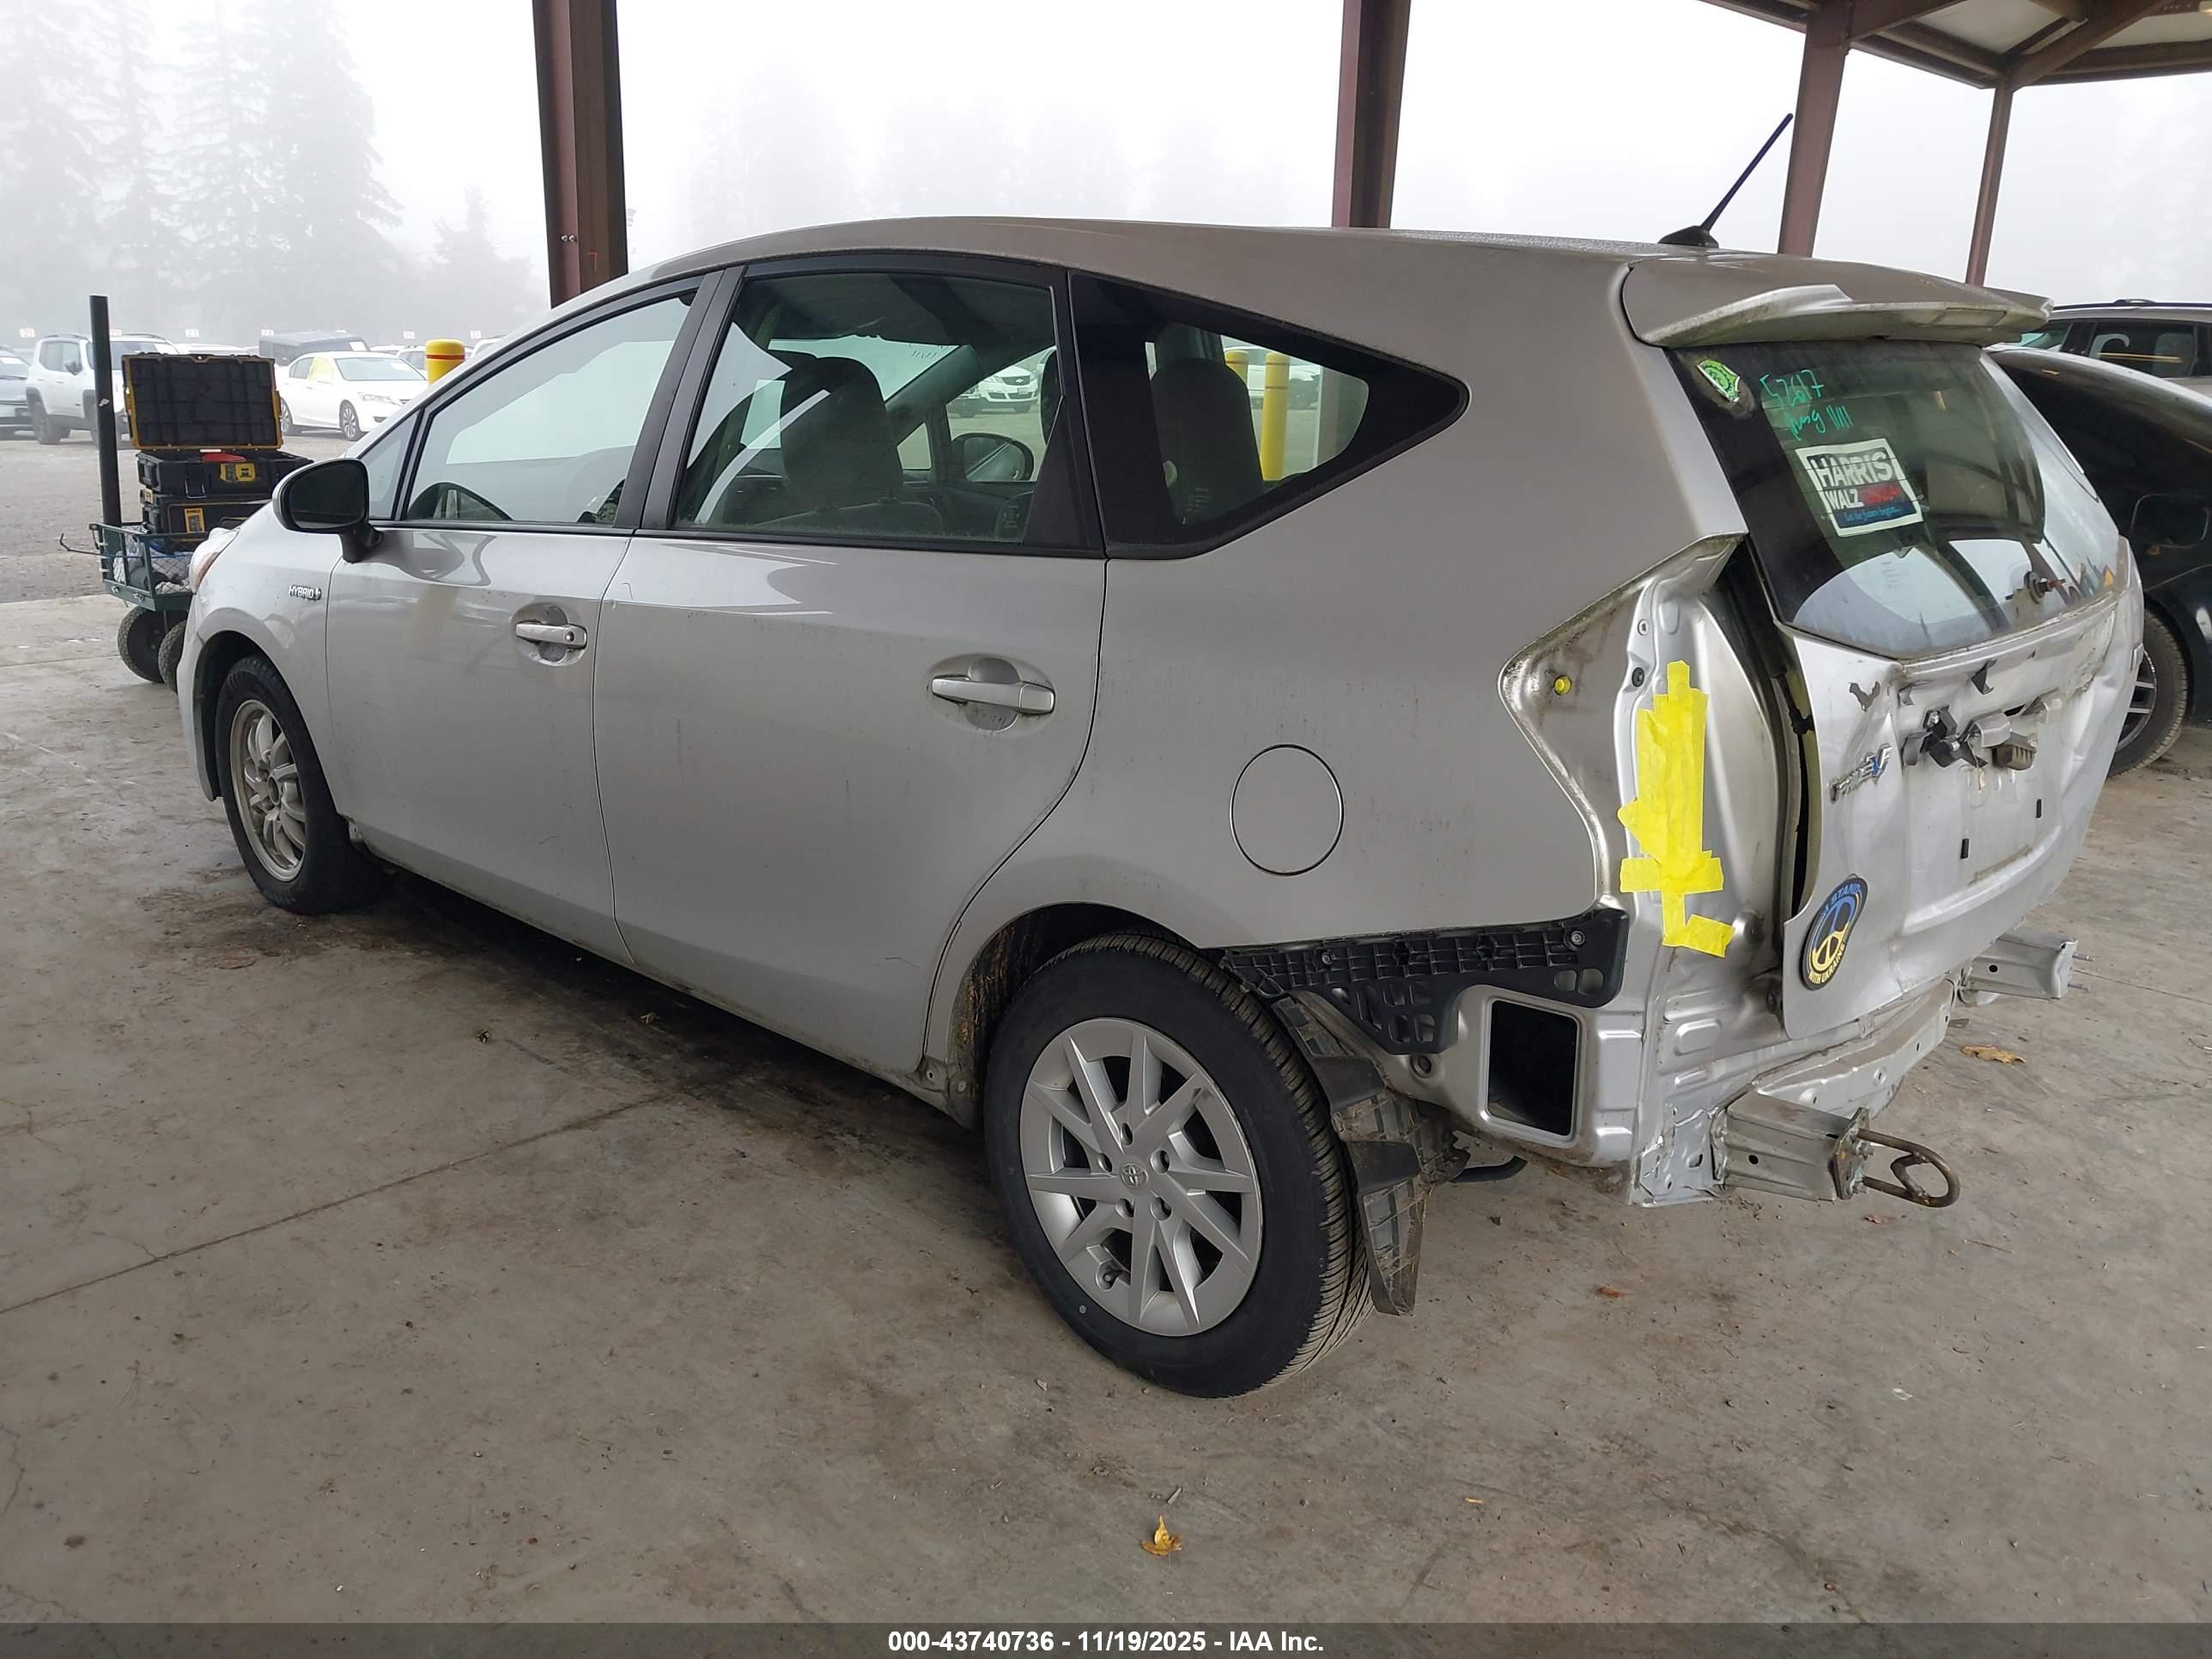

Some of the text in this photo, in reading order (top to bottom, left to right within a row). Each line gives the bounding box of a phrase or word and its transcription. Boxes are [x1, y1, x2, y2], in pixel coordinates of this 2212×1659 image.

[1810, 451, 1893, 487] HARRIS
[1825, 489, 1864, 510] WALZ
[289, 586, 314, 599] HYBRID
[1831, 883, 1862, 904] STAND
[1820, 944, 1845, 983] UKRAINE
